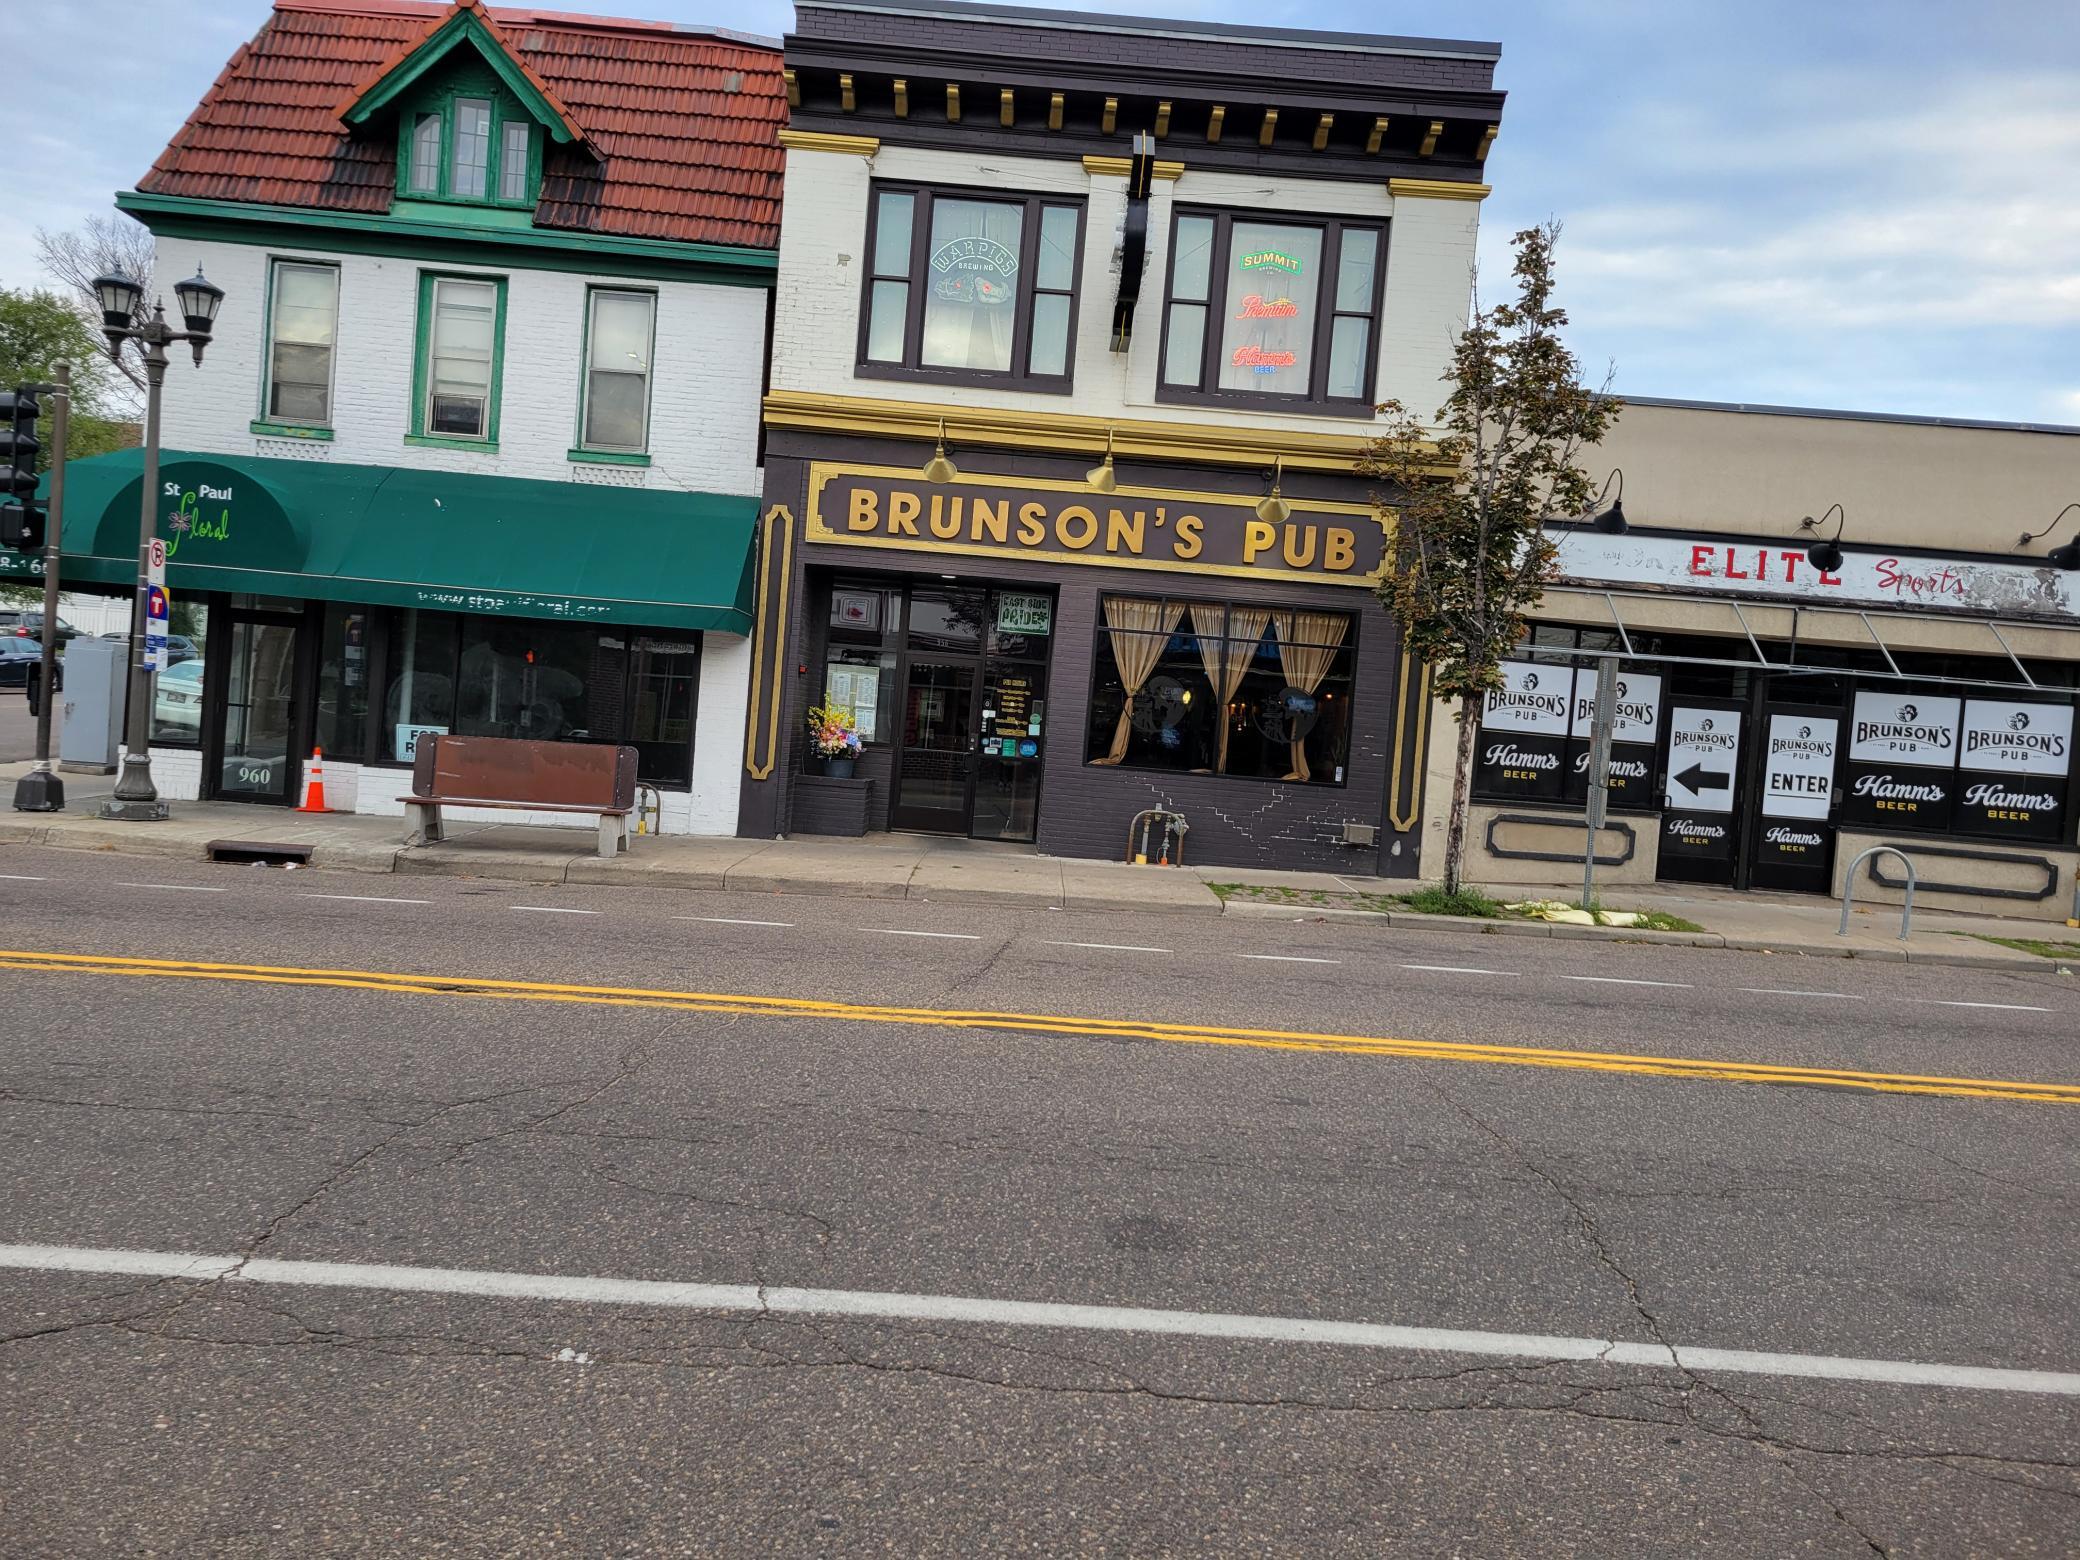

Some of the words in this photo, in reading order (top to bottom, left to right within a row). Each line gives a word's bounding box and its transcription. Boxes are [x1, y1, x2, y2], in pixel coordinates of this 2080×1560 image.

[934, 241, 1015, 272] WARPIGS
[1244, 252, 1298, 270] SUMMIT
[958, 262, 994, 271] BREWING
[164, 482, 181, 496] St
[199, 484, 233, 500] Paul
[846, 488, 1204, 560] BRUNSON'S
[1243, 521, 1355, 571] PUB
[1689, 545, 1841, 585] ELIT
[1875, 558, 1965, 596] Sports
[1003, 596, 1026, 607] EAST
[1027, 598, 1047, 609] SIDE
[1002, 607, 1040, 625] PRIDE
[1488, 692, 1565, 717] BRUNSON'S
[1578, 698, 1654, 725] BRSON'S
[1515, 711, 1537, 721] PUB
[1611, 721, 1626, 729] UB
[1674, 731, 1735, 749] BRUNSON'S
[1857, 722, 1952, 749] BRUNSON'S
[1967, 730, 2065, 757] BRUNSON'S
[1772, 739, 1832, 757] BRUNSON'S
[1889, 741, 1916, 752] PUB
[2001, 750, 2028, 761] PUB
[1483, 744, 1559, 769] Hamm's
[1573, 752, 1647, 777] Hmm's
[239, 767, 271, 784] 960
[1503, 770, 1537, 780] BEER
[1608, 779, 1626, 788] ER
[1771, 773, 1829, 793] ENTER
[1852, 775, 1945, 801] Hamm's
[1876, 801, 1917, 812] BEER
[1962, 784, 2058, 811] Hamm's
[1987, 810, 2030, 821] BEER
[1668, 819, 1725, 838] Hamm's
[1765, 827, 1822, 845] Hamm's
[1682, 837, 1709, 845] BEER
[1779, 844, 1805, 852] BEER
